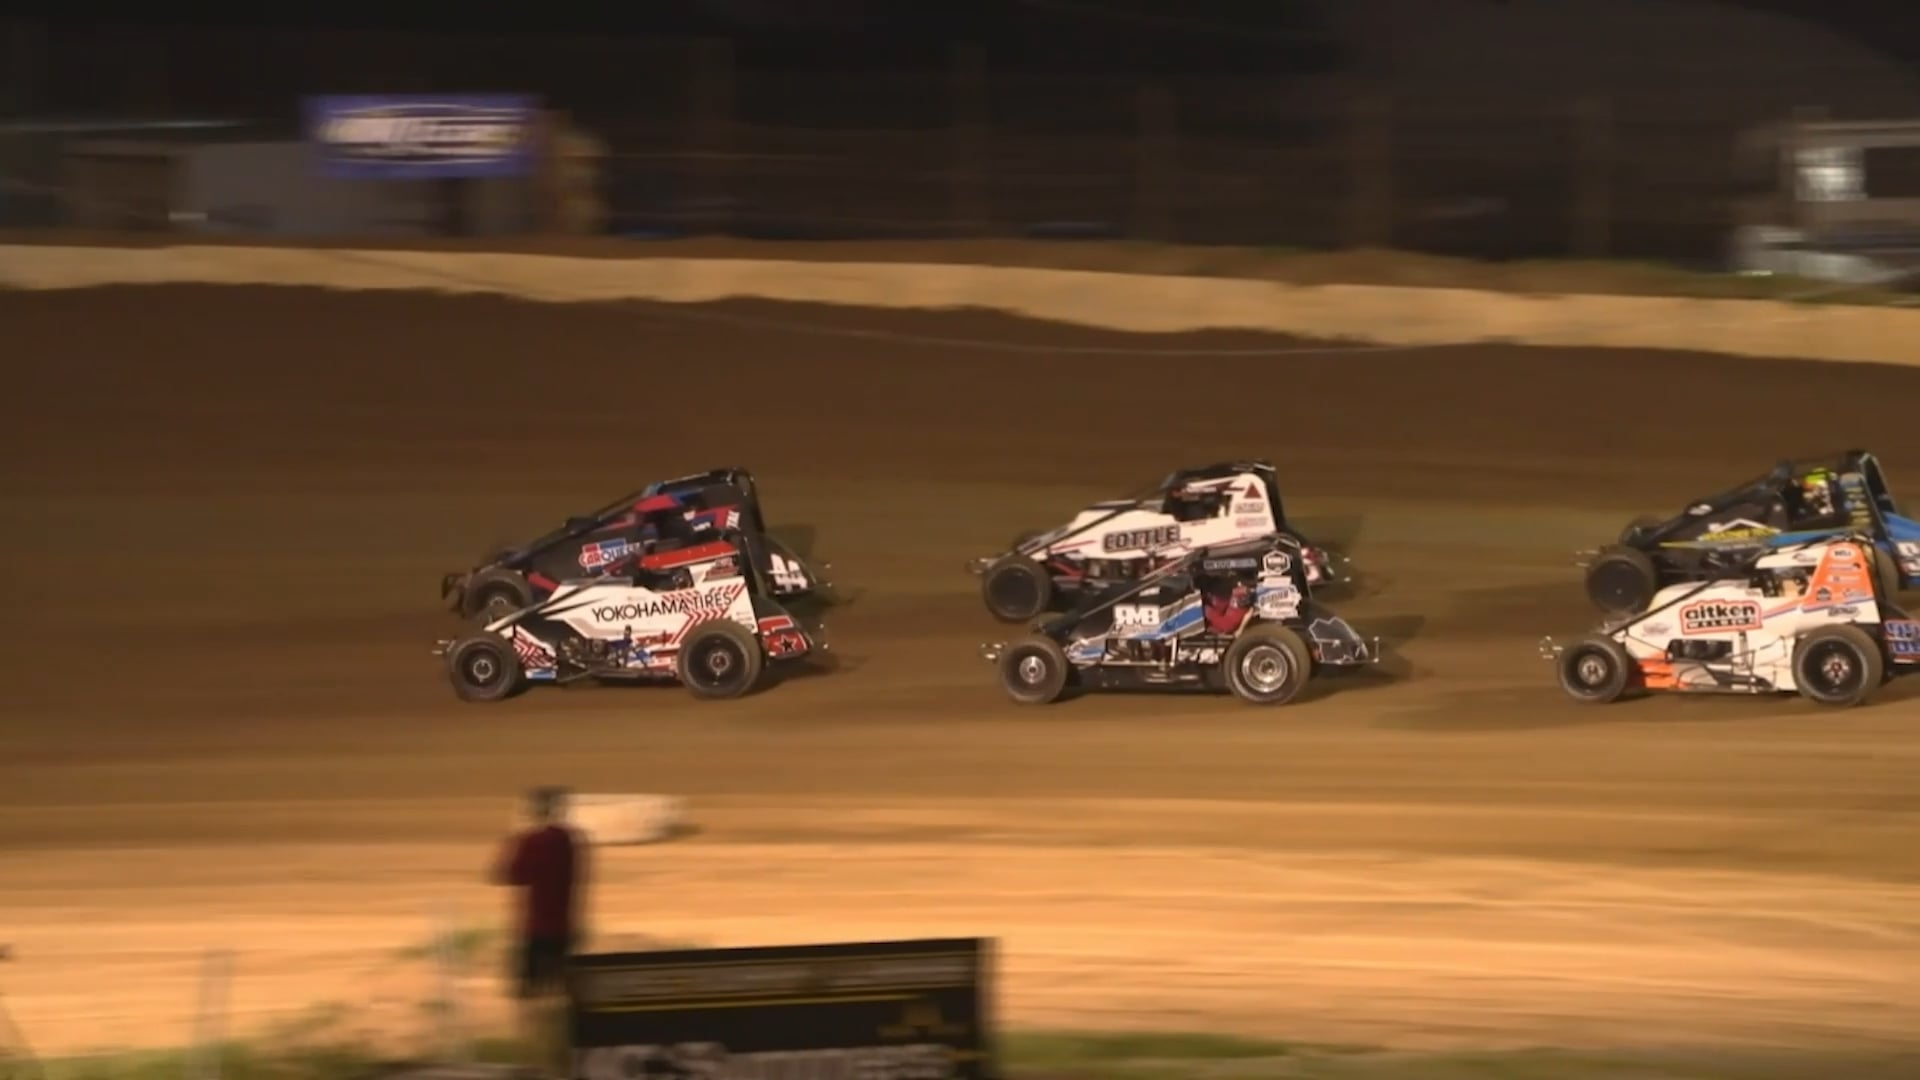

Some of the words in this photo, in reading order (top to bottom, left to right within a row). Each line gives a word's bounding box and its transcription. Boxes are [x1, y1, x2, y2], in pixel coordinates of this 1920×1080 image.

[1104, 525, 1180, 553] COTTLE
[592, 599, 689, 622] YOKOHAMA
[692, 592, 733, 610] TIRES
[1685, 605, 1755, 619] aitken
